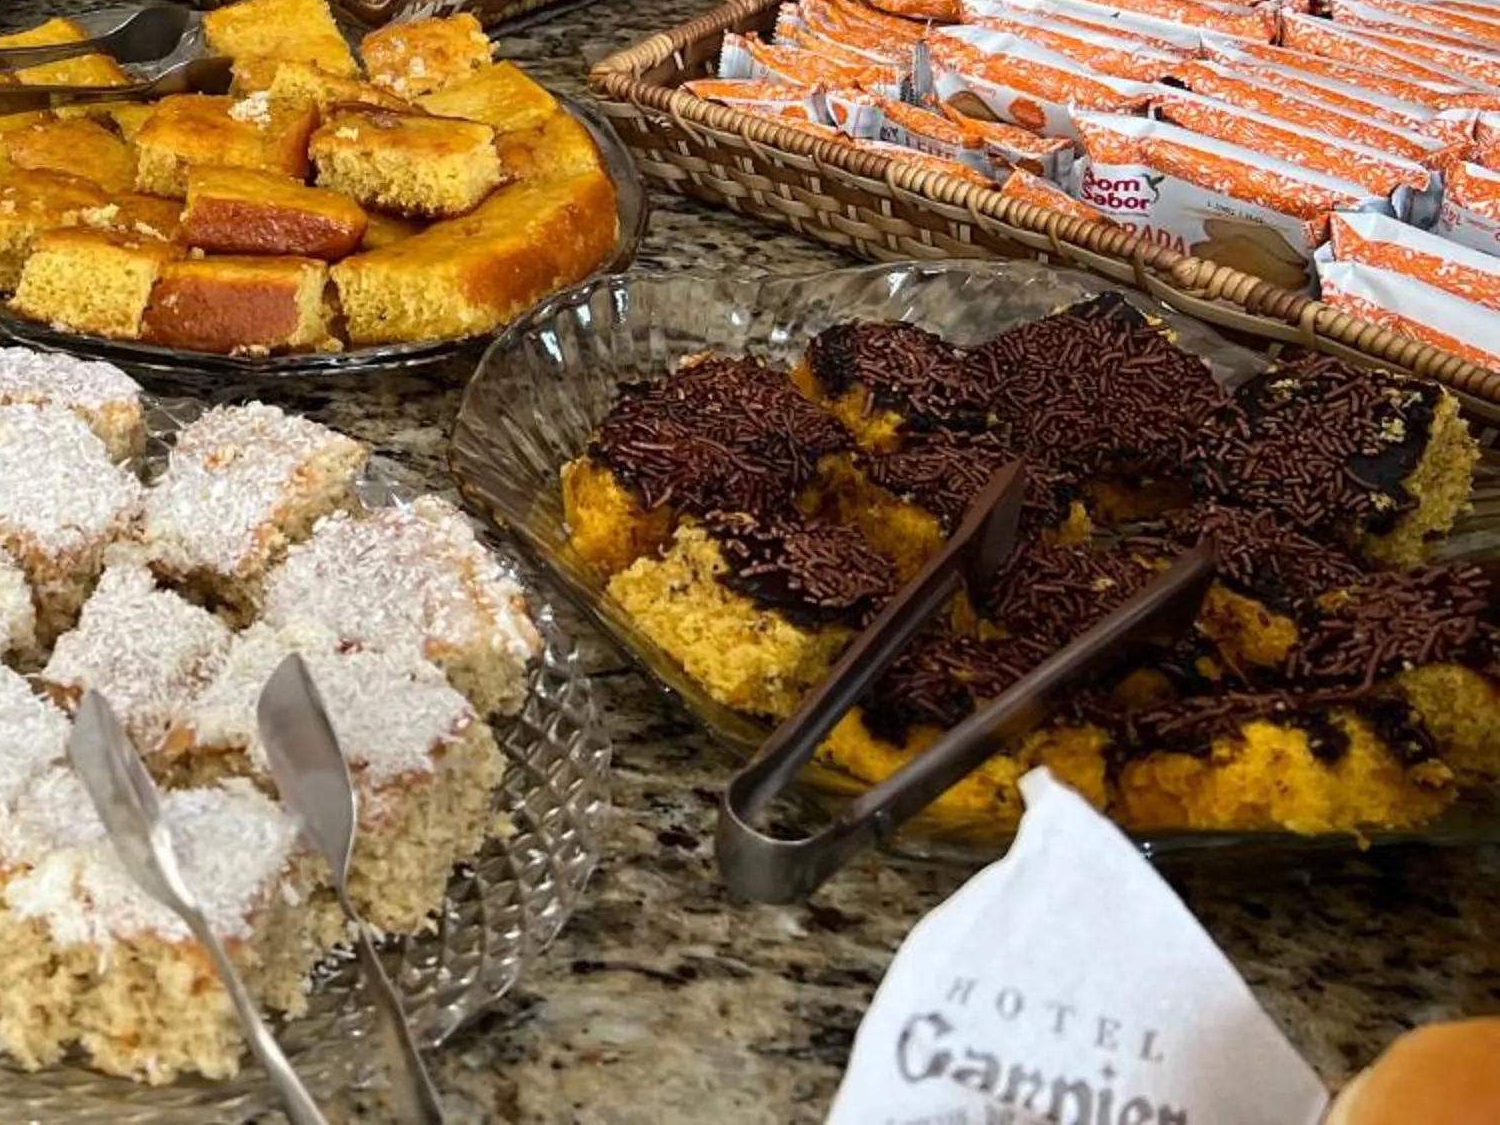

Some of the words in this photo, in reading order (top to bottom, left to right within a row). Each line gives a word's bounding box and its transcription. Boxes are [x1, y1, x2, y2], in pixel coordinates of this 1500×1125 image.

[1082, 166, 1140, 192] Bom
[1080, 187, 1150, 210] Sabor
[946, 976, 1166, 1064] HOTEL
